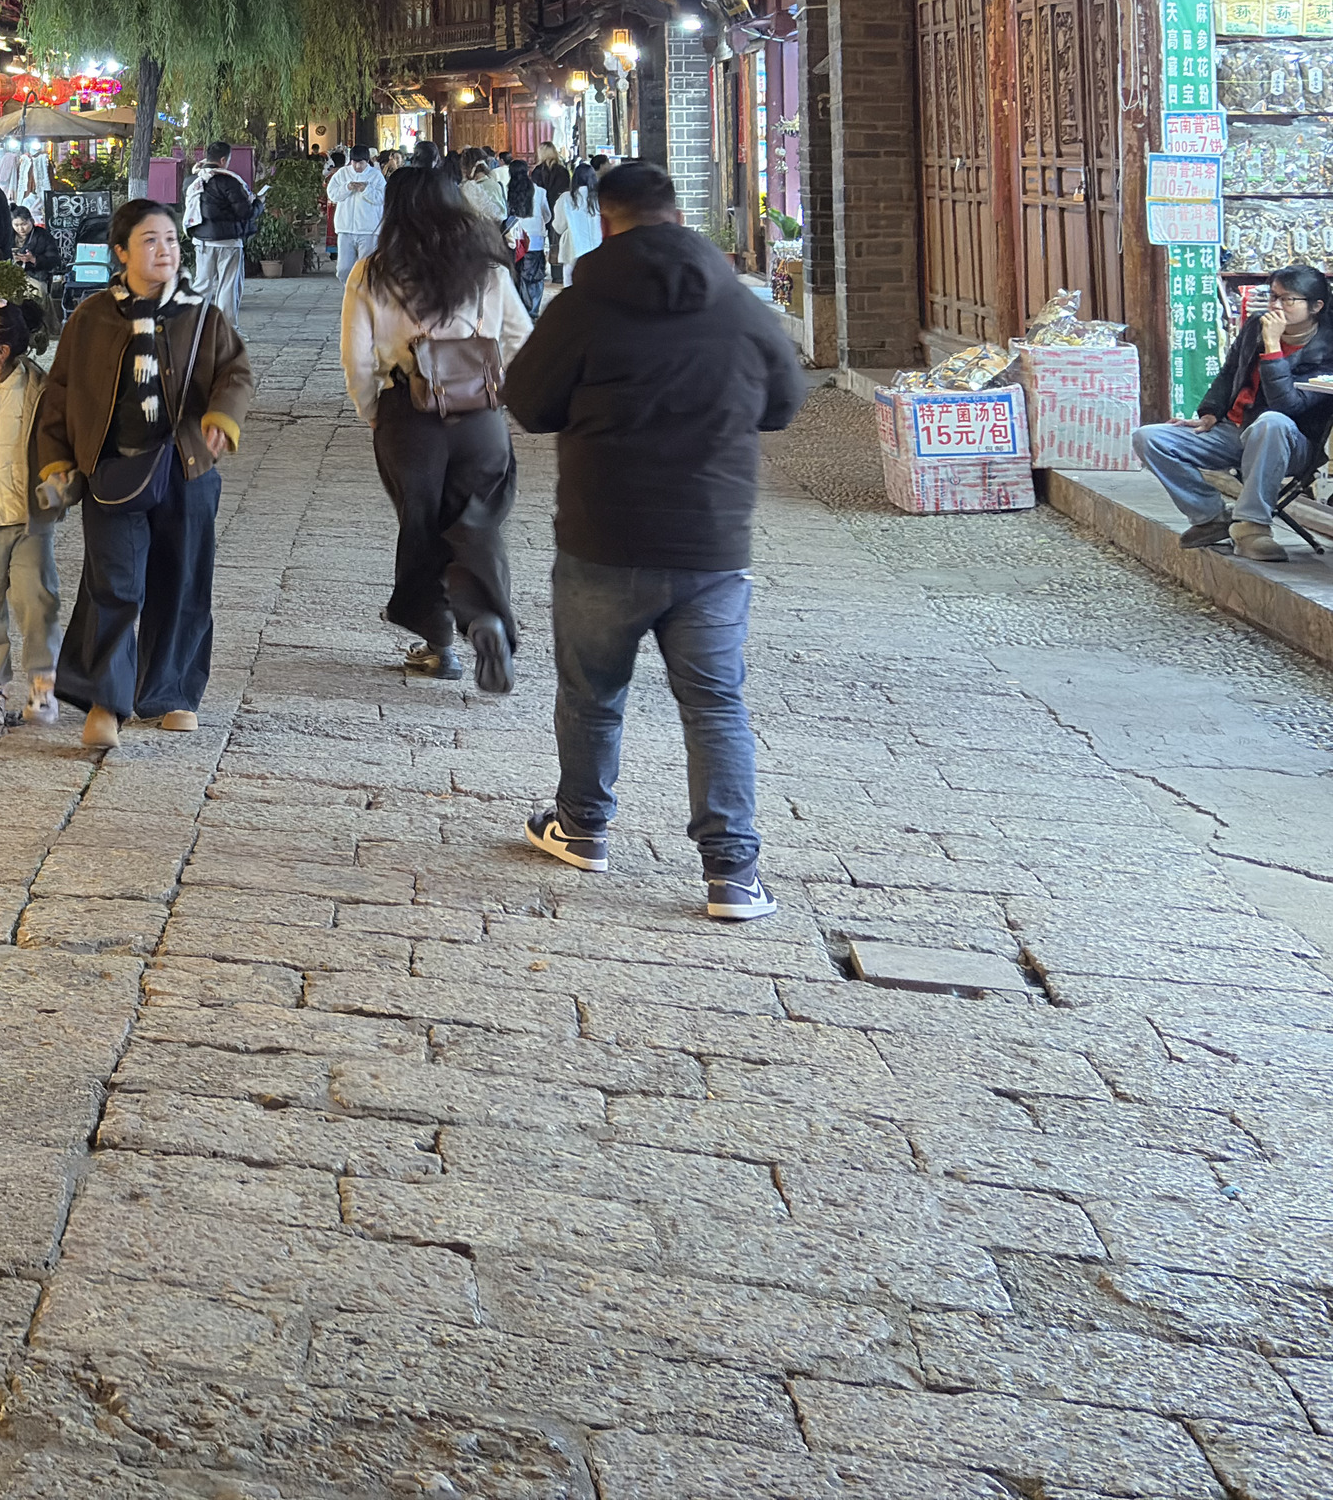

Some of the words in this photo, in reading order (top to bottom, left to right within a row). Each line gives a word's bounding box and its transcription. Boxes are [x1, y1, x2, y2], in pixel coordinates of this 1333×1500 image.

[1166, 2, 1208, 23] 天麻
[1167, 28, 1208, 50] 高丽参
[1167, 56, 1209, 78] 藏红花
[1167, 115, 1220, 134] 云南普洱
[1153, 162, 1216, 179] 云南普洱茶
[1153, 205, 1216, 221] 南普洱茶
[919, 401, 1008, 424] 特产菌汤包
[921, 423, 1011, 446] 15元/包
